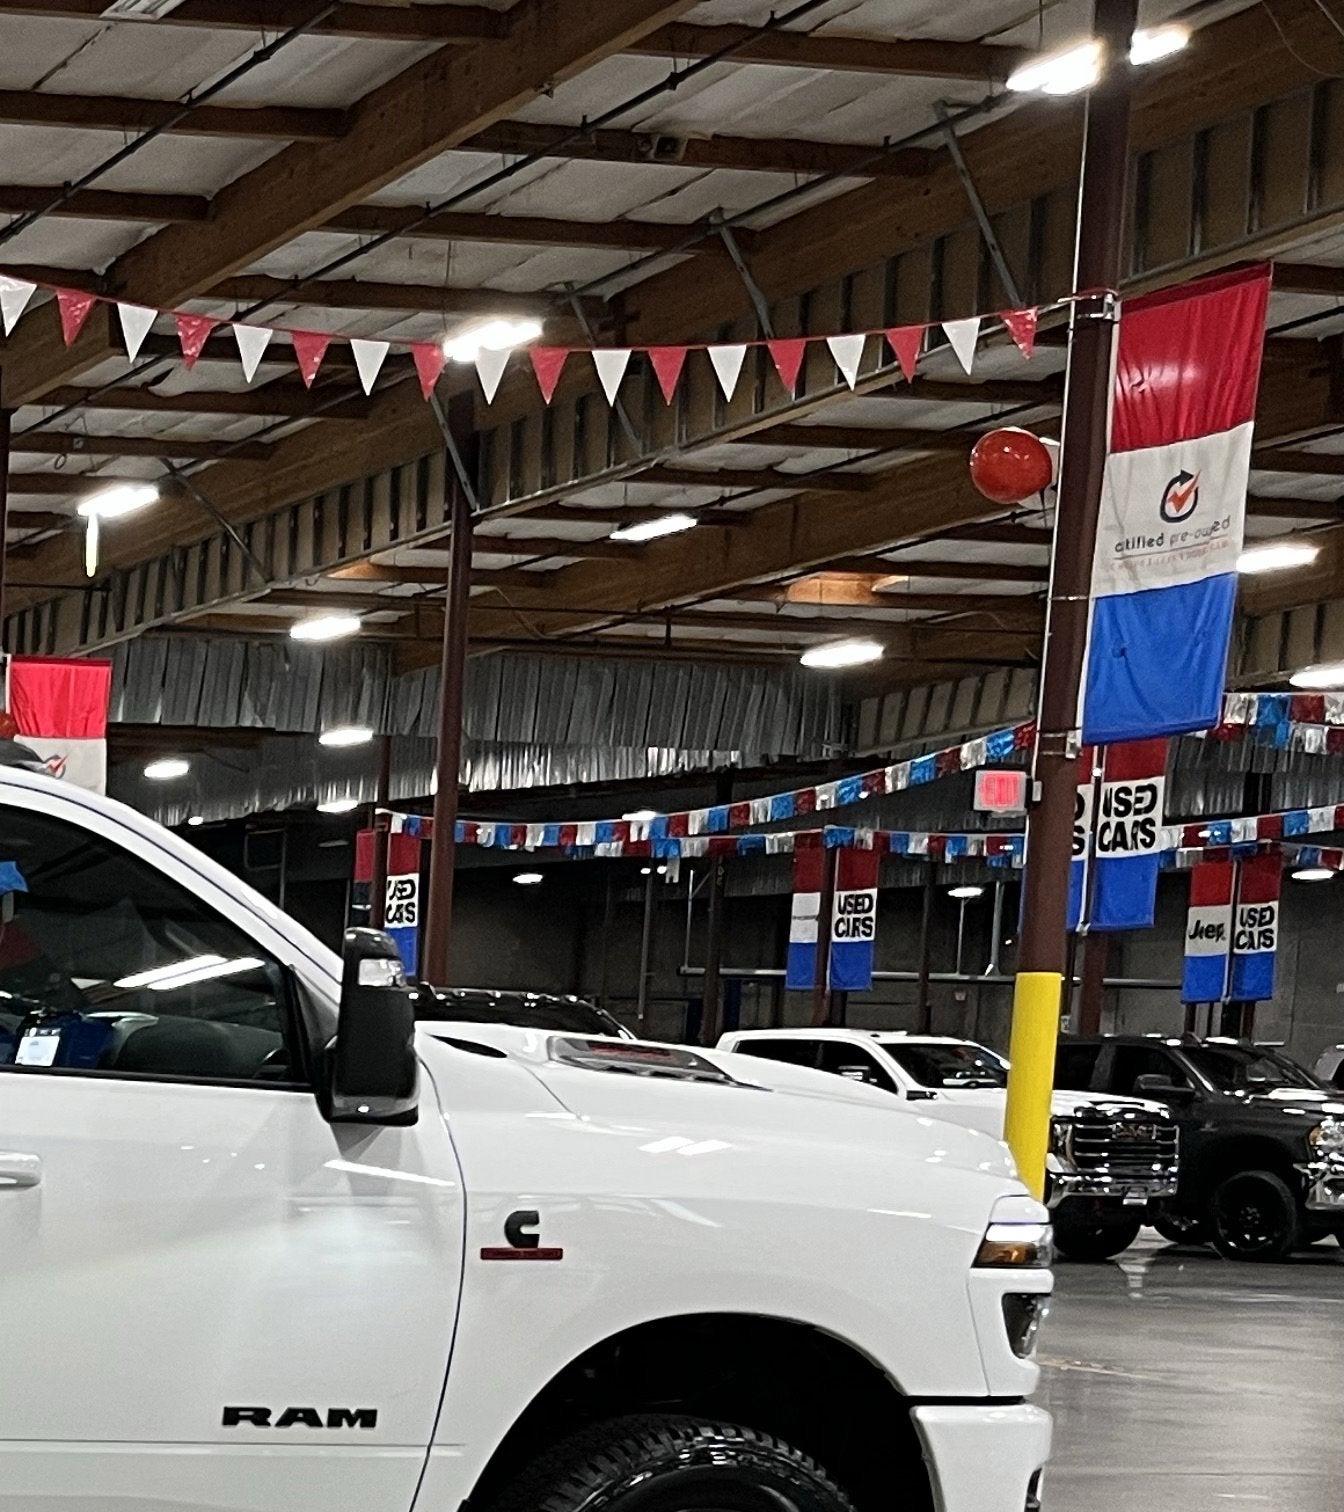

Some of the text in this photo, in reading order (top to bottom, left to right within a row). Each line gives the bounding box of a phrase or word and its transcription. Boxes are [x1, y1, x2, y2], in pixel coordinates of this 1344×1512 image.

[1098, 817, 1157, 853] CARS
[385, 901, 416, 924] CAS
[837, 893, 874, 915] USED
[834, 916, 874, 938] CARS
[1239, 905, 1275, 928] USED
[1235, 928, 1275, 950] CARS
[222, 1406, 378, 1428] RAM
